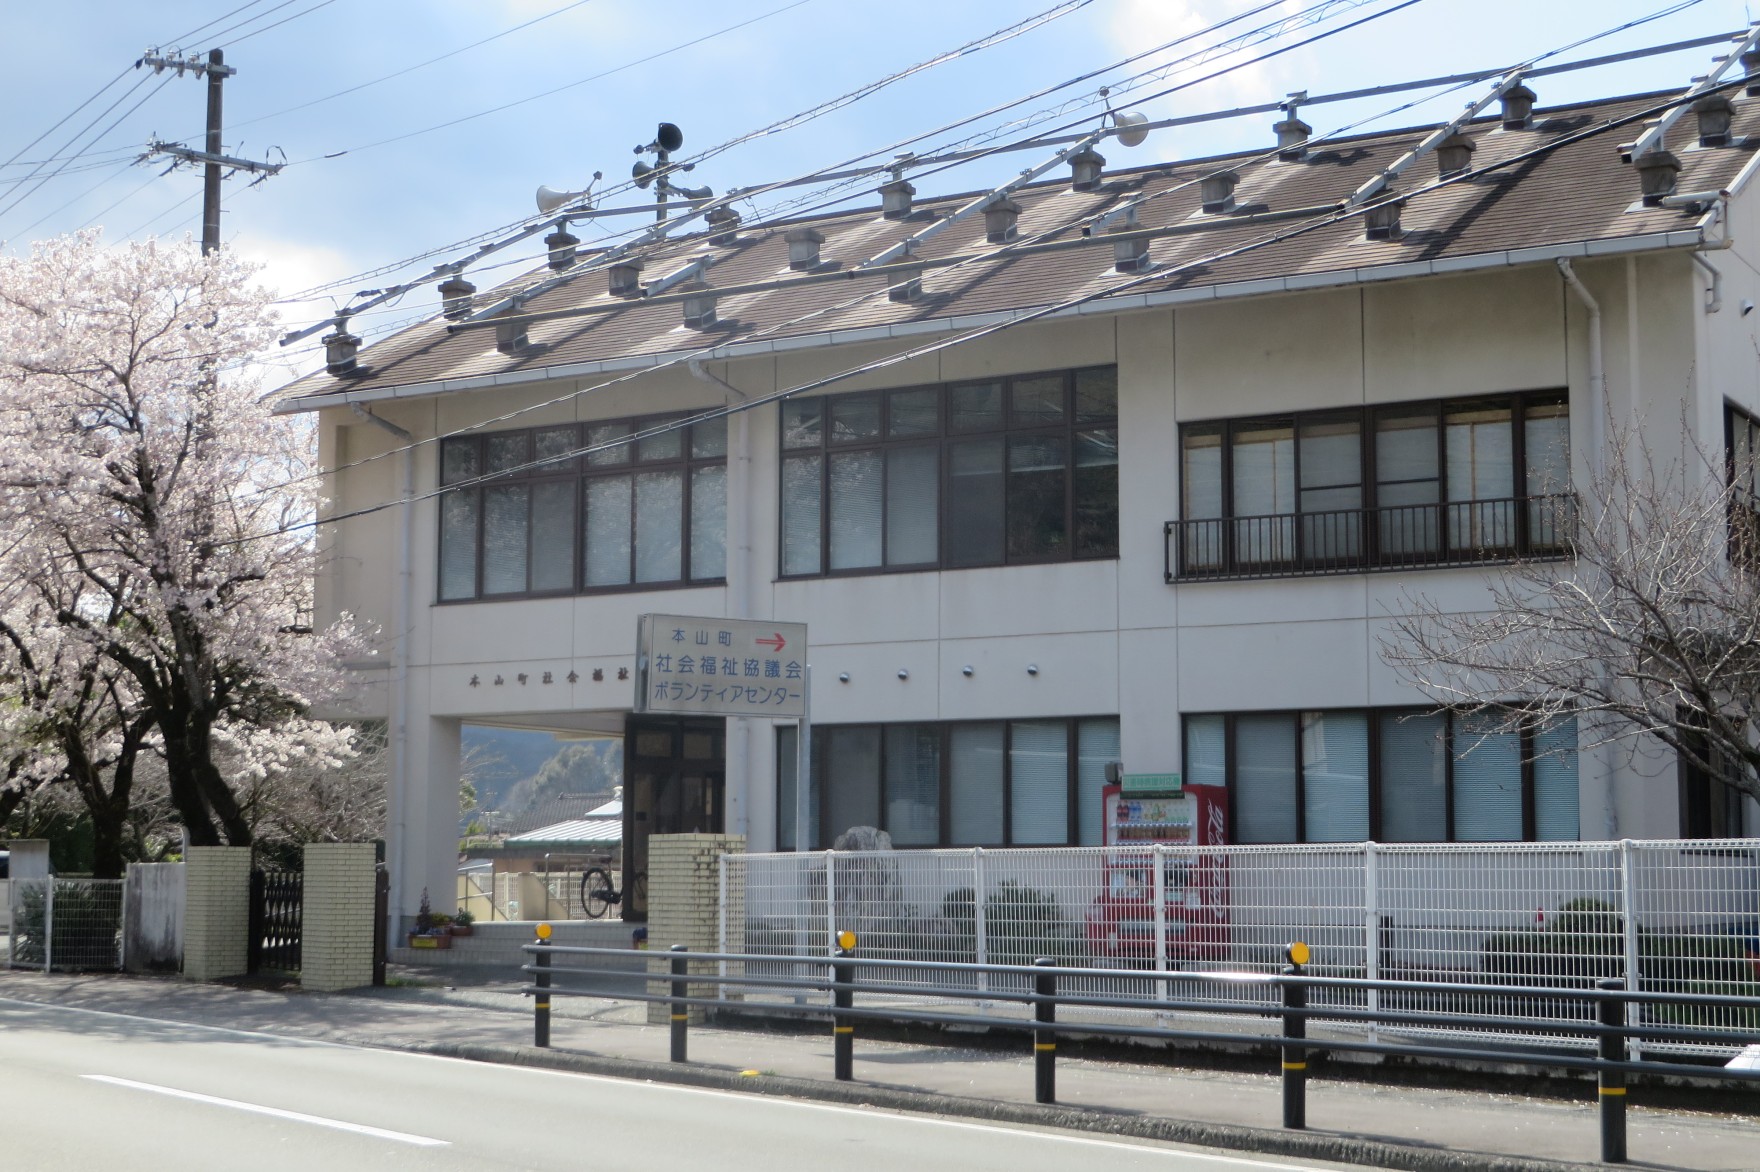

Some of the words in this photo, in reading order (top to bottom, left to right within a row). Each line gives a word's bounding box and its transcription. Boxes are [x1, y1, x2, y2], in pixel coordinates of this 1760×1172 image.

[672, 628, 732, 646] 本山町
[656, 653, 802, 679] 社会福祉協議会
[655, 681, 801, 705] ボランティアセンター
